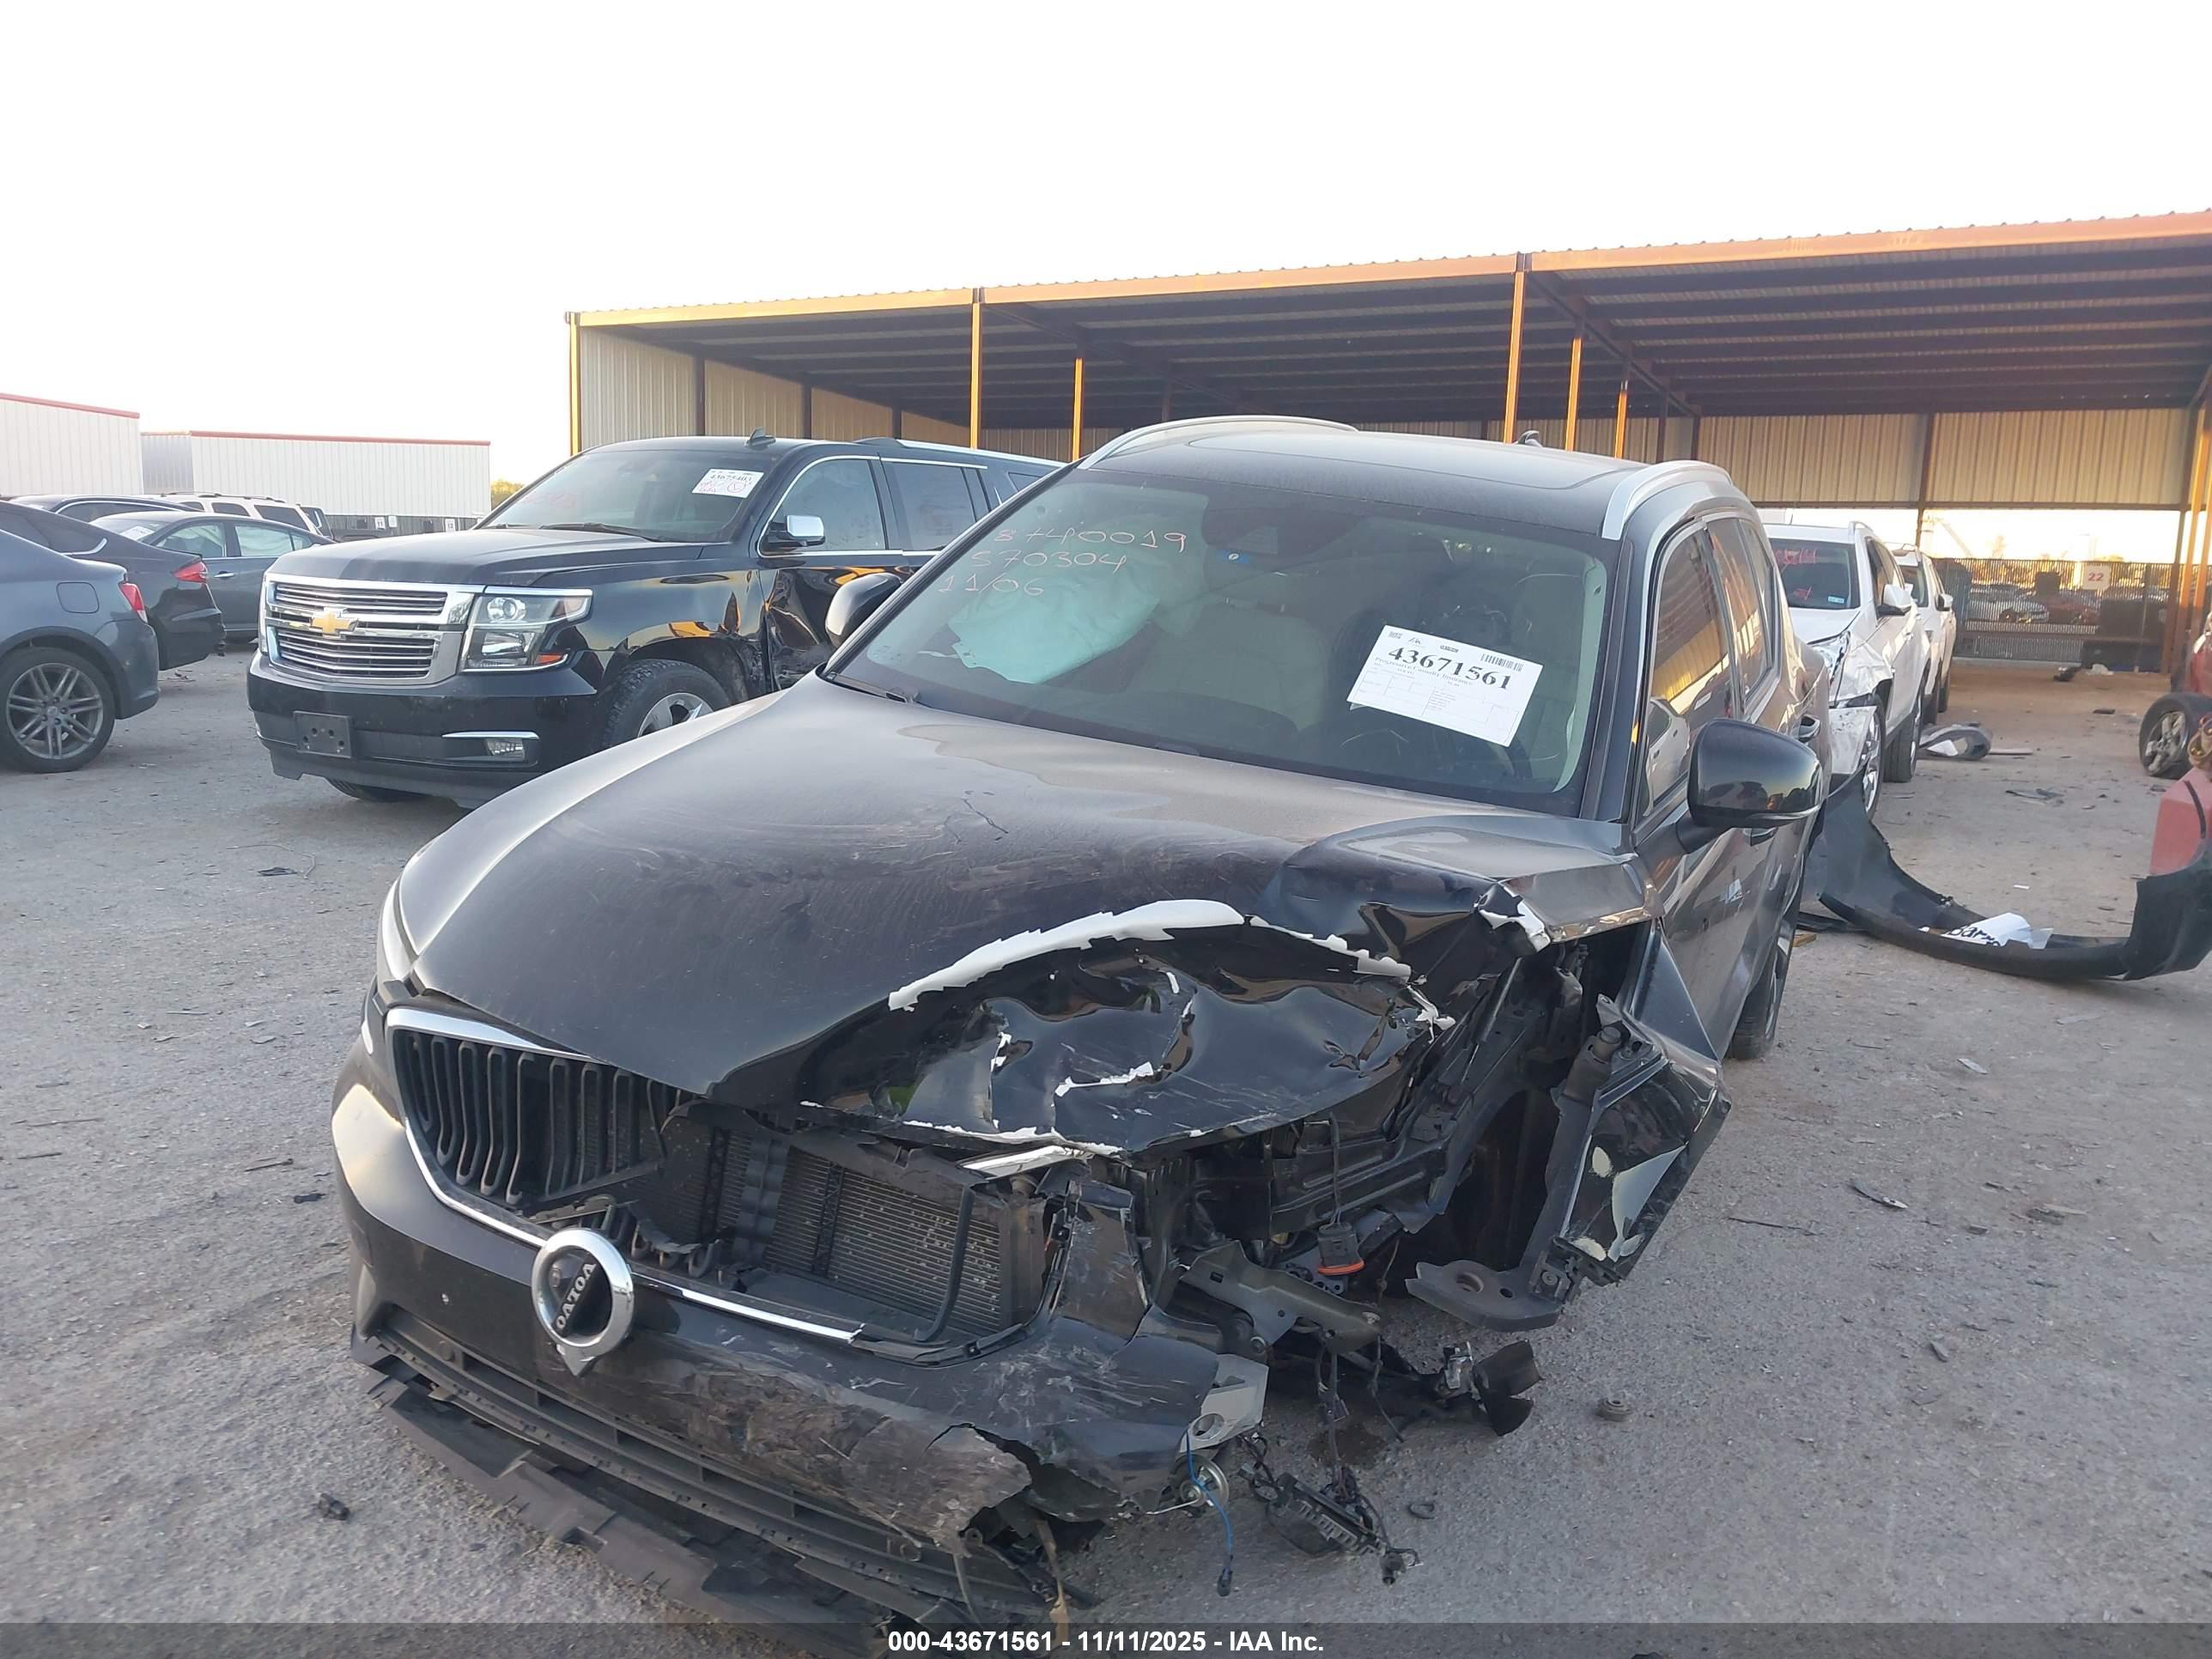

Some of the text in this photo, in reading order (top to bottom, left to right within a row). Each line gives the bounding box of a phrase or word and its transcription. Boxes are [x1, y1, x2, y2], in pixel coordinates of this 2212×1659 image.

[938, 572, 1045, 597] 11/06
[2087, 572, 2104, 582] 22
[1388, 646, 1512, 690] 43671561
[555, 1262, 597, 1331] VOLVO
